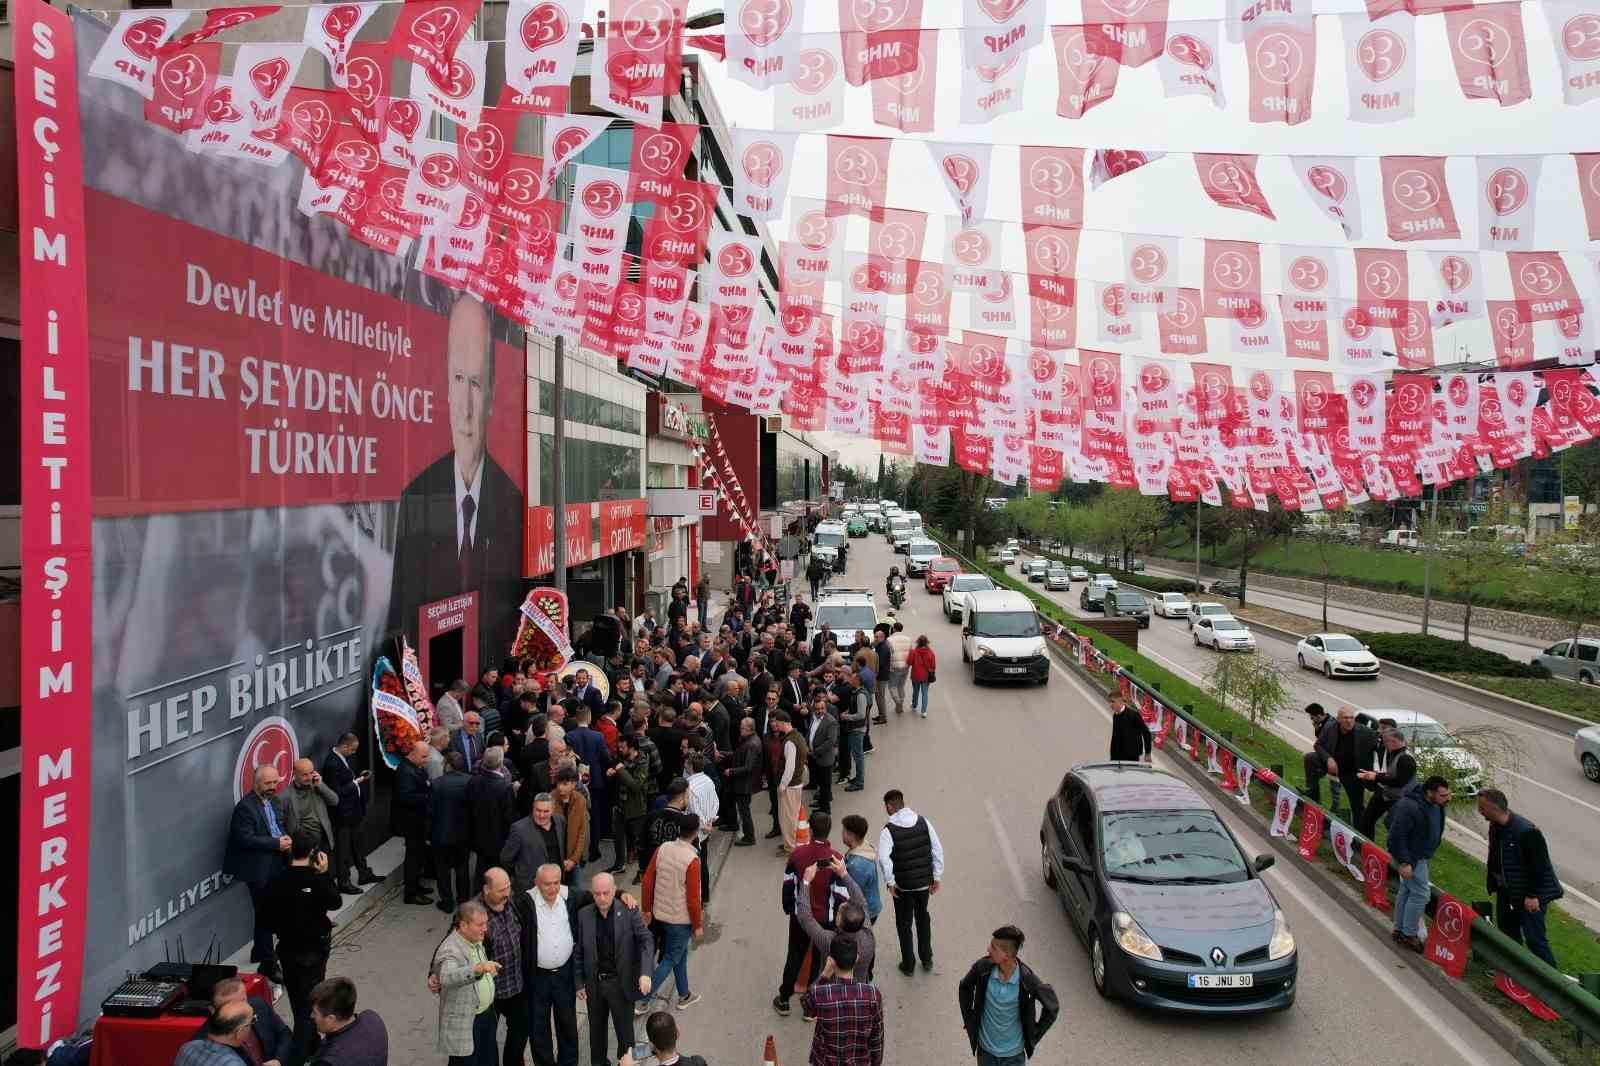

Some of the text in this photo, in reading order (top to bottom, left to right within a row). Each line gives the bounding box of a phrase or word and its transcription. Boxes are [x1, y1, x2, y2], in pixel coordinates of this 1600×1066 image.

[186, 263, 412, 362] Devlet ve Milletiyle
[128, 335, 433, 423] HER ŞEYDEN ÖNCE
[245, 418, 377, 474] TÜRKİYE
[32, 22, 73, 1044] SEÇİM İLETİŞİM MERKEZİ
[701, 496, 712, 508] E
[538, 535, 587, 572] MEKAL
[127, 638, 361, 760] HEP BİRLİKTE
[1199, 975, 1250, 986] 16 JNU 90
